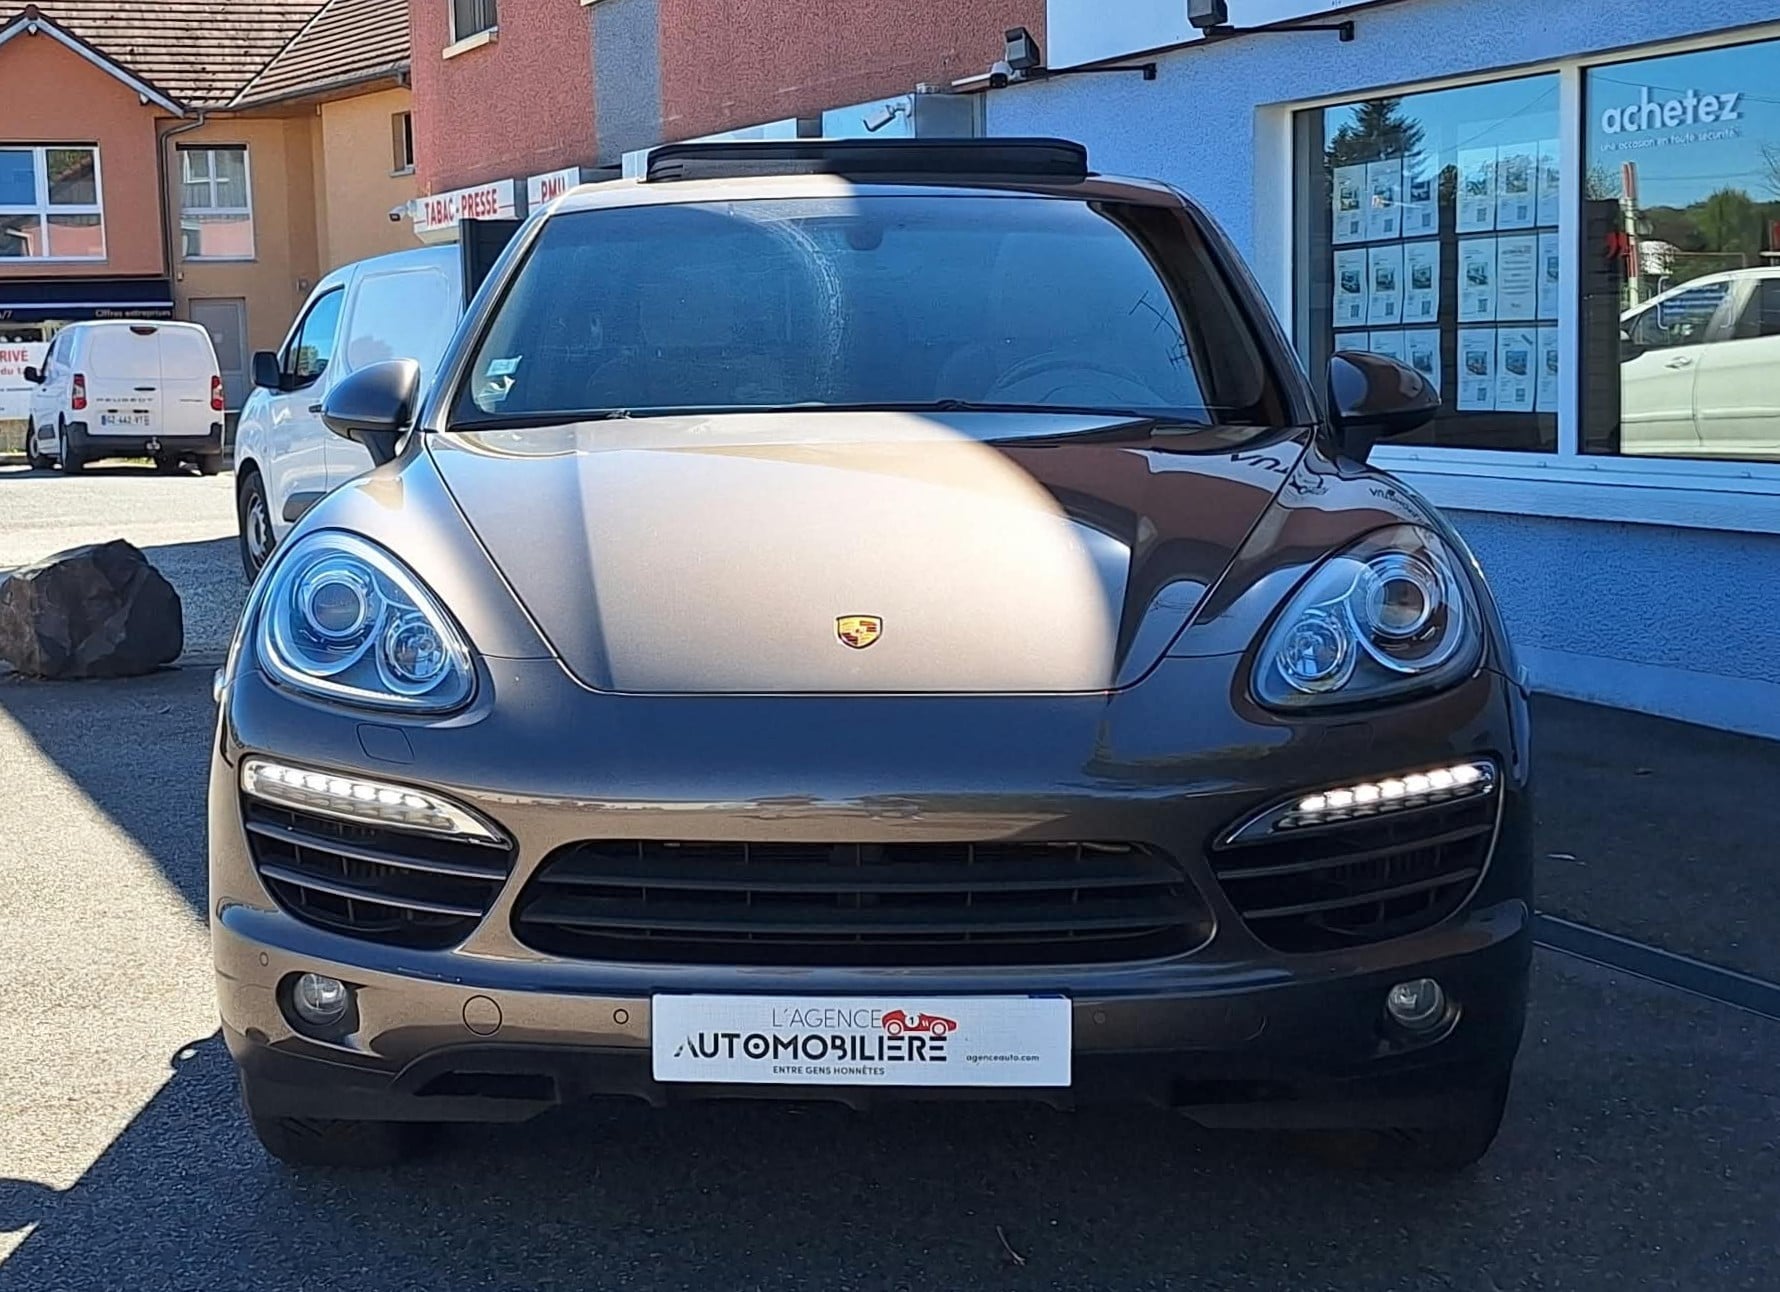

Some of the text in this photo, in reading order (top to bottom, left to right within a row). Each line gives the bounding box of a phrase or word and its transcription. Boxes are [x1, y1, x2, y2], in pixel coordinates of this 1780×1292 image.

[1601, 86, 1740, 134] achetez
[424, 197, 454, 226] TABAC
[461, 189, 498, 217] PRESSE
[773, 1064, 885, 1075] ENTRE GENS HONNÊTES
[966, 1054, 1040, 1065] agenceauto.com
